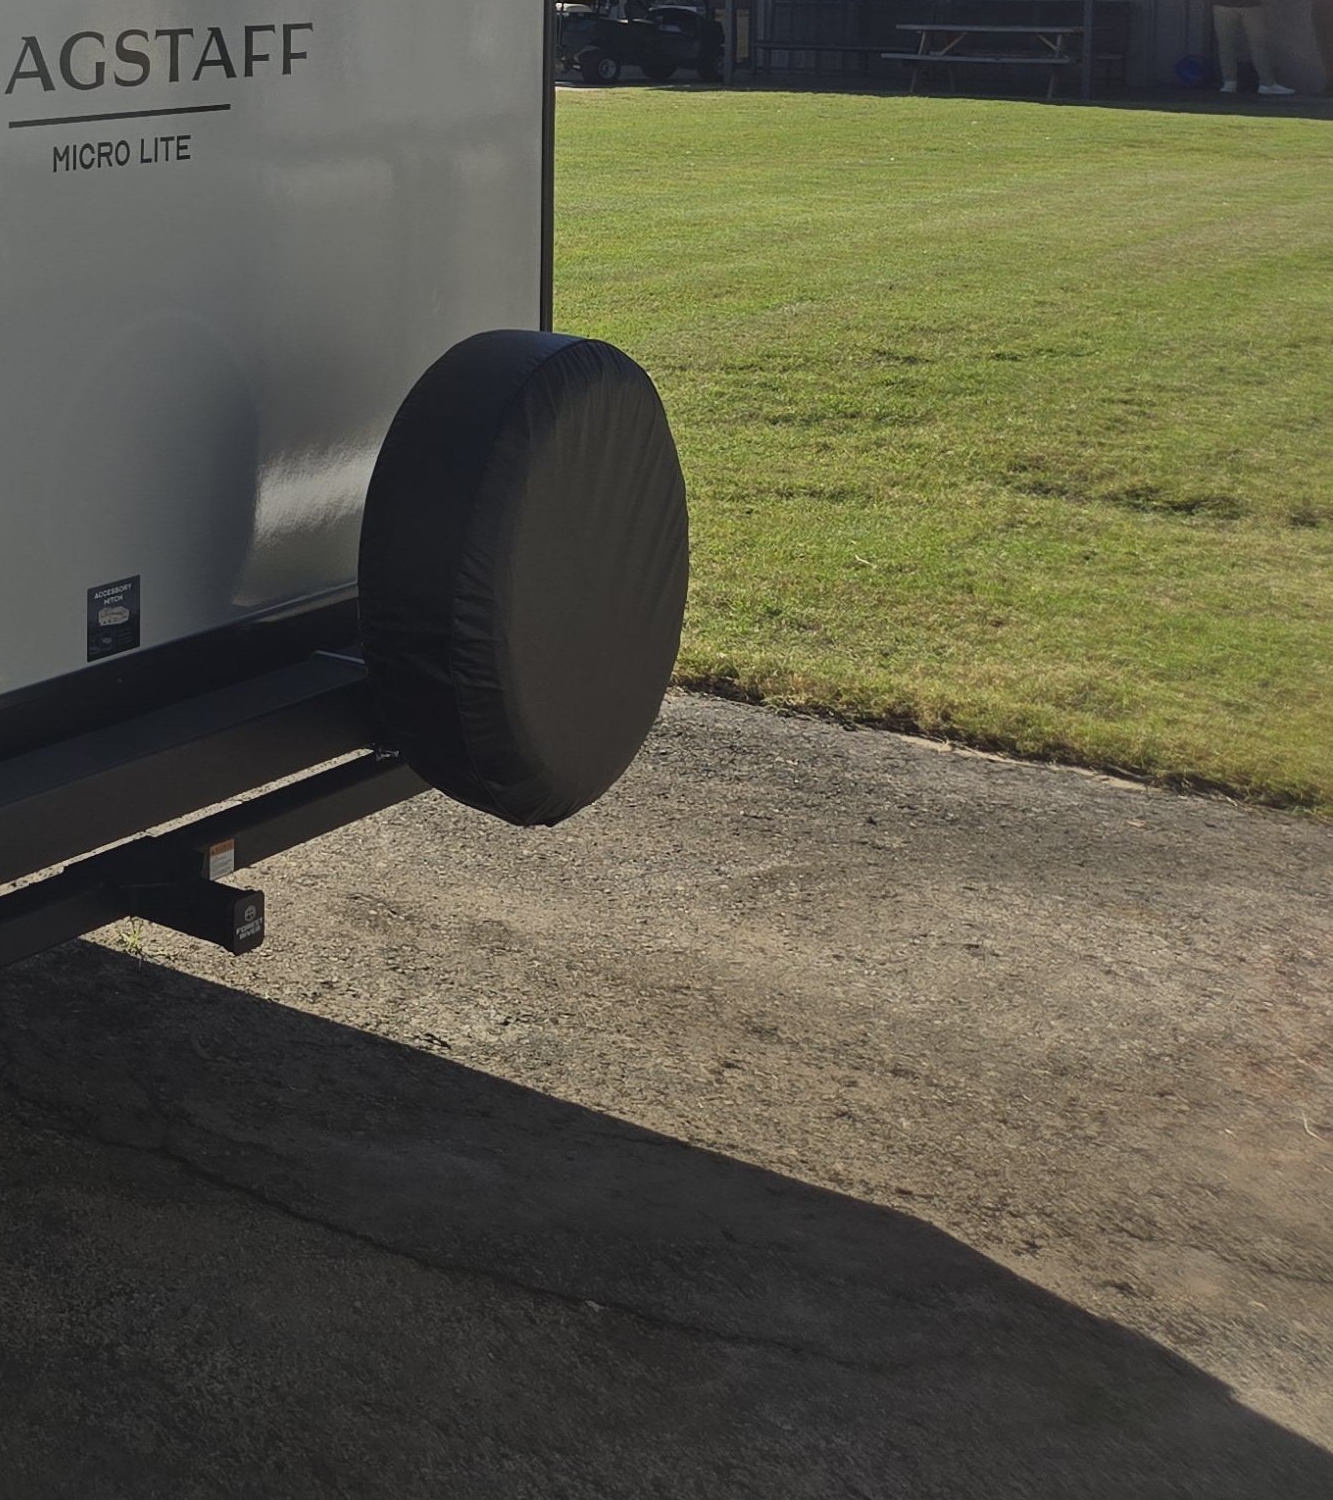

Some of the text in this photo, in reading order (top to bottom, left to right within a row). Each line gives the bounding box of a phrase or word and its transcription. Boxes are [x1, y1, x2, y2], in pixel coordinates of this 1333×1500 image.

[53, 135, 191, 173] MICRO LITE
[94, 583, 132, 599] ACCESSORY
[104, 594, 124, 605] HITCH
[236, 917, 263, 935] FOREST
[239, 925, 261, 940] RIVER
